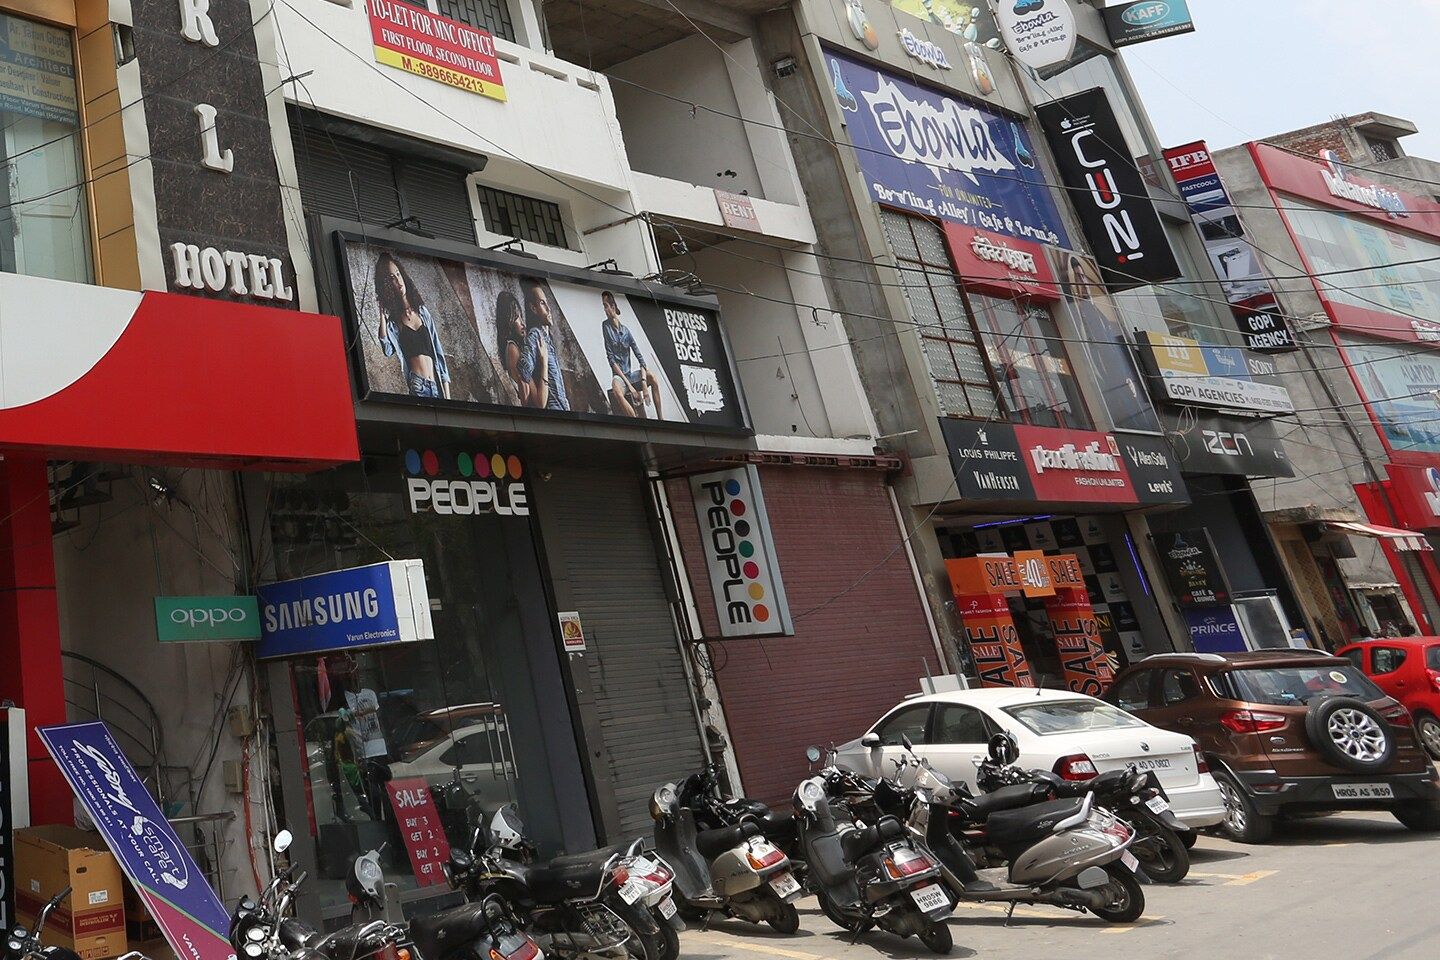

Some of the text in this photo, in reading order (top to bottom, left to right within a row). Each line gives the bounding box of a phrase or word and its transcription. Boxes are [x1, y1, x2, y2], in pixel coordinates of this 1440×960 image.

[1126, 4, 1165, 22] KAFF
[409, 10, 434, 36] FOR
[433, 19, 458, 45] MNC
[457, 27, 495, 57] OFFICE
[382, 28, 405, 48] FIRST
[467, 60, 494, 77] FLOOR
[15, 52, 72, 75] Architect
[873, 91, 997, 163] Ebowla
[1168, 150, 1209, 169] IFB
[722, 201, 755, 219] RENT
[873, 183, 937, 216] Bowling
[938, 201, 970, 224] Alley
[978, 212, 1004, 231] Cafe
[1015, 220, 1060, 244] Lounge
[170, 241, 293, 303] HOTEL
[663, 308, 708, 332] EXPRESS
[1248, 314, 1275, 331] GOPI
[668, 325, 702, 346] YOUR
[1248, 330, 1290, 349] AGENCY
[674, 342, 704, 363] EDGE
[1248, 359, 1275, 377] SONY
[1169, 383, 1196, 399] GOPI
[1198, 387, 1246, 404] AGENCIES
[958, 448, 1018, 461] LOUIS PHILIPPE
[1074, 477, 1099, 486] FASHION
[408, 478, 530, 516] PEOPLE
[699, 480, 752, 625] PEOPLE
[985, 560, 1020, 587] SALE
[1050, 559, 1081, 584] SALE
[171, 608, 246, 628] oppo
[265, 588, 379, 633] SAMSUNG
[346, 628, 396, 643] Varun Electronics
[1190, 622, 1236, 635] PRINCE
[72, 739, 142, 815] Godrej
[395, 788, 427, 809] SALE
[1358, 788, 1371, 798] AS
[70, 747, 118, 817] PROFESSIONALS
[128, 833, 146, 858] YOUR
[144, 860, 161, 886] CALL
[405, 817, 417, 828] BUY
[410, 831, 423, 842] GET
[142, 834, 169, 871] care
[144, 824, 182, 876] smart
[415, 849, 428, 860] BUY
[420, 862, 433, 875] GET
